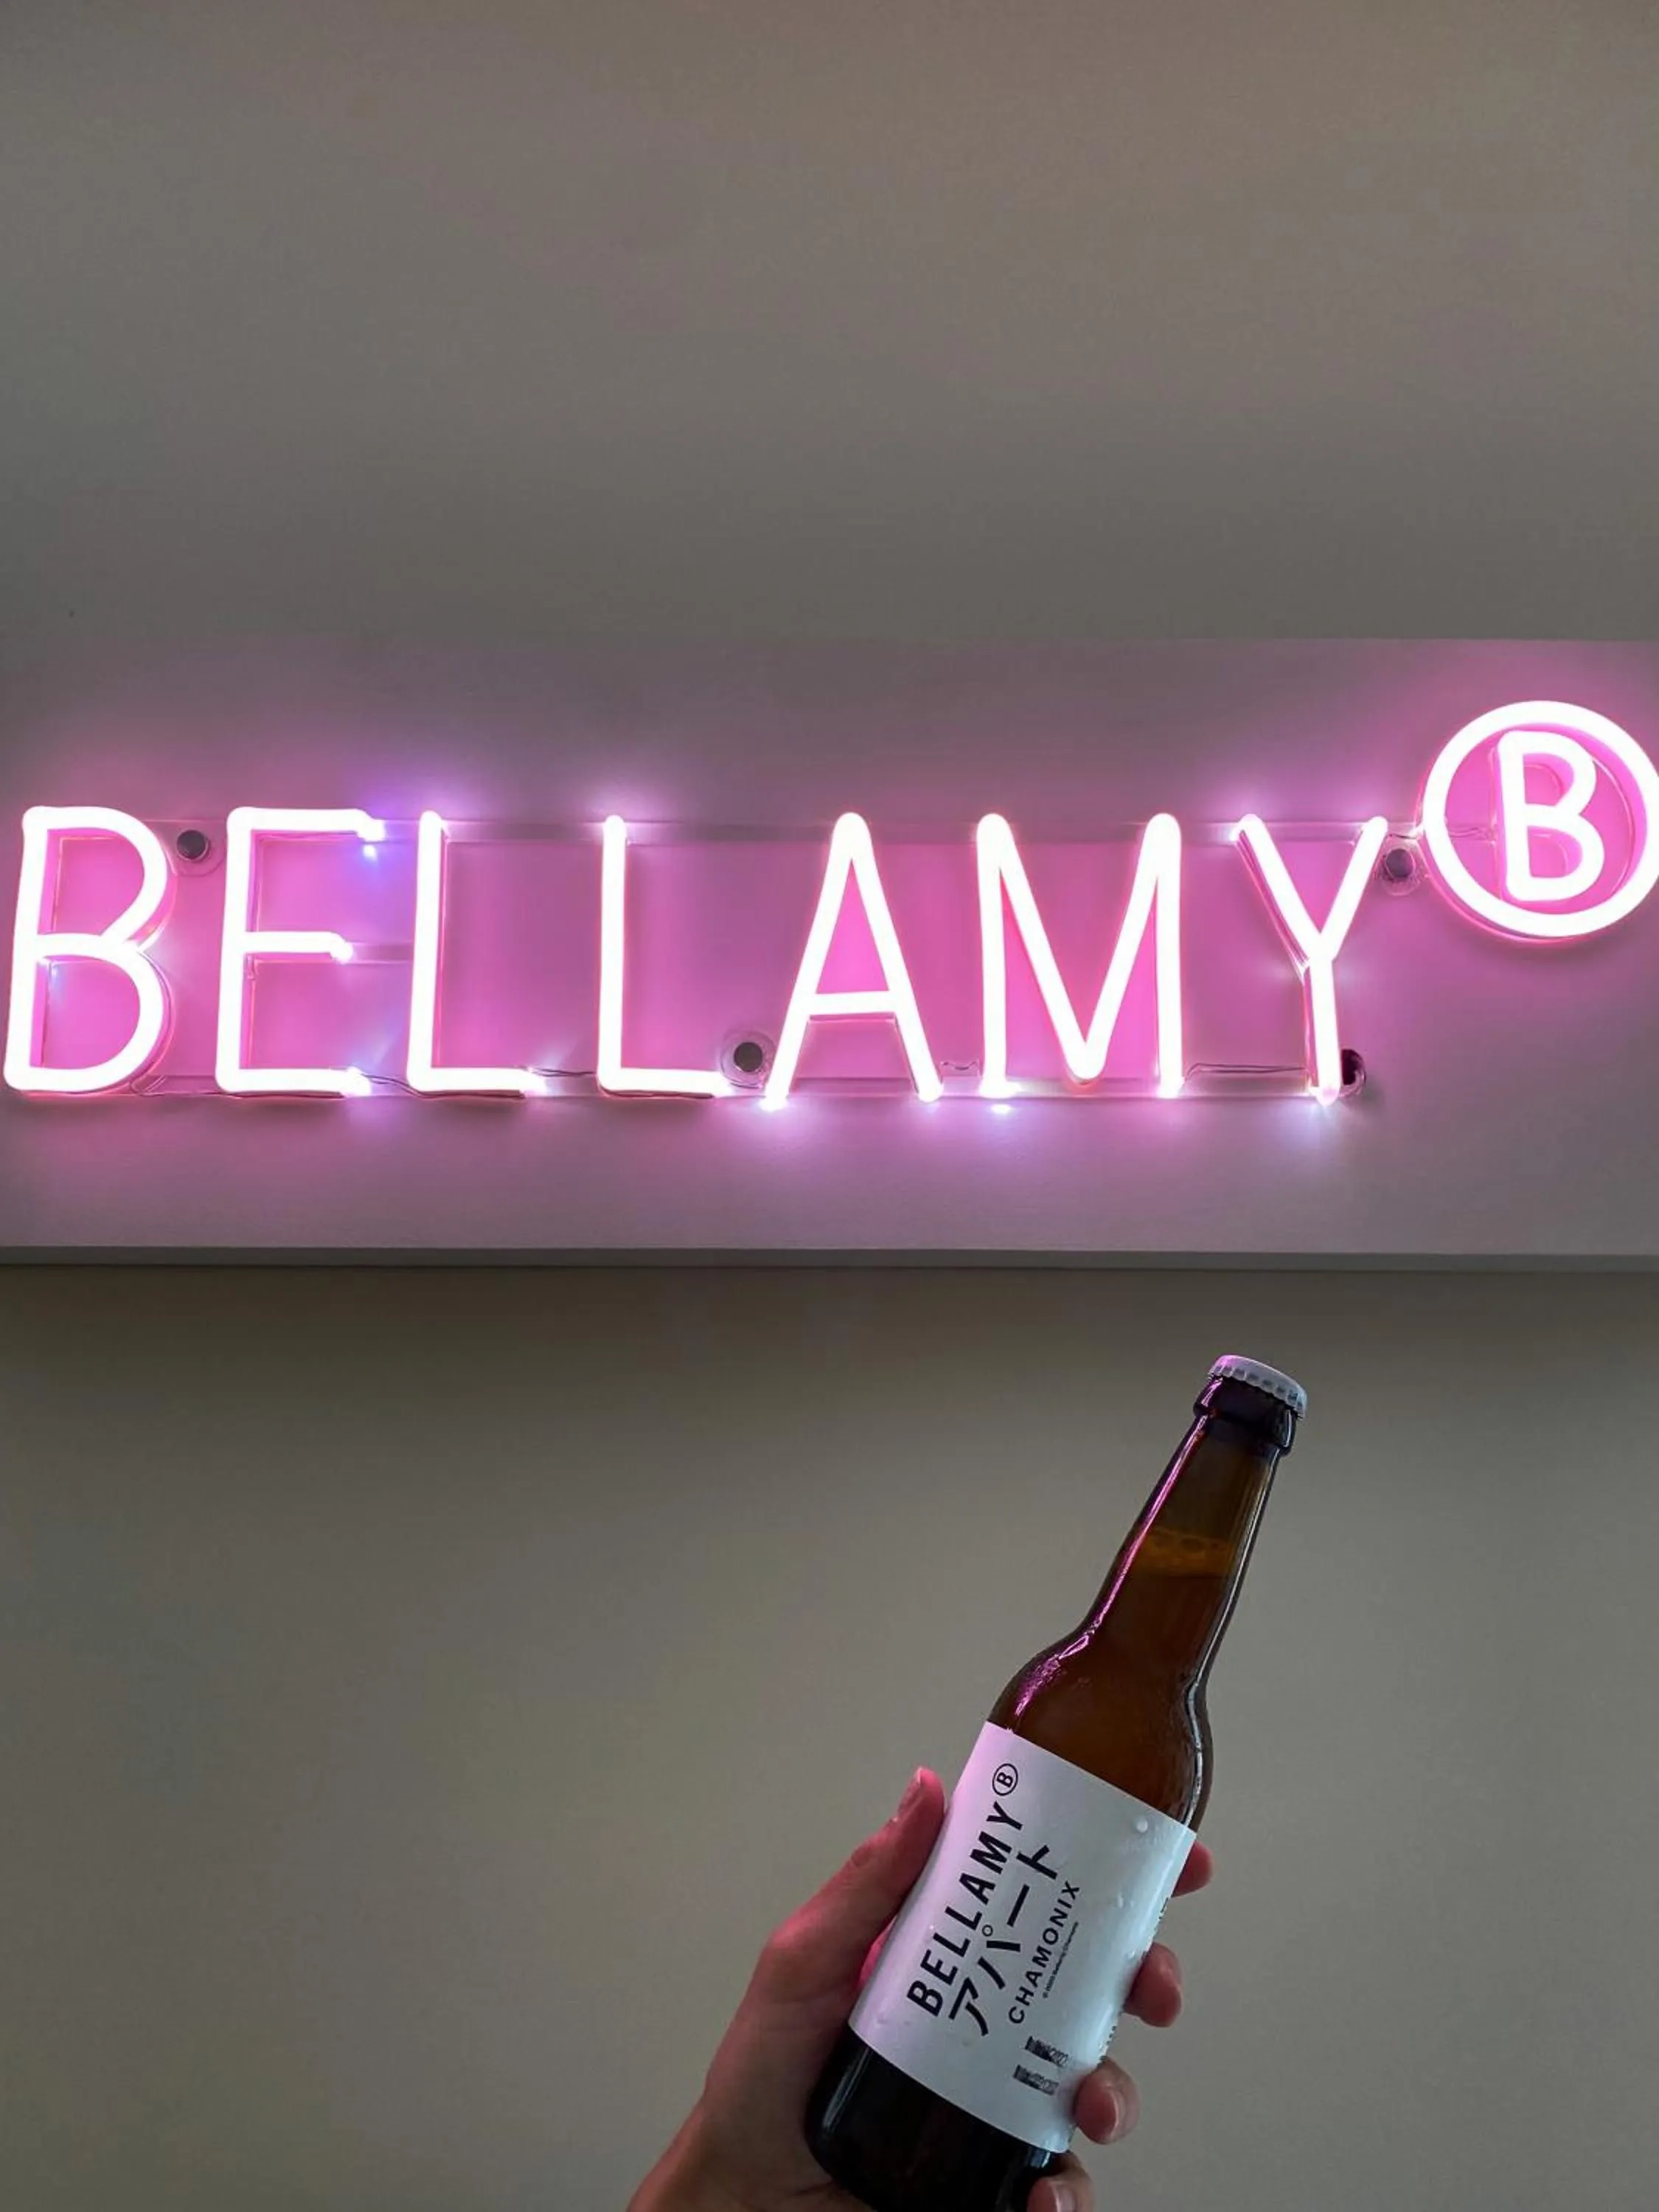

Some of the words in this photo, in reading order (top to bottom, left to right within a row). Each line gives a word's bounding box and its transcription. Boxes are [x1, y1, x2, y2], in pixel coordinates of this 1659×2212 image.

[4, 806, 1388, 1110] BELLAMY
[906, 1801, 1023, 2017] BELLAMY
[947, 1844, 1058, 2037] アパート
[1008, 1880, 1080, 2025] CHAMONIX
